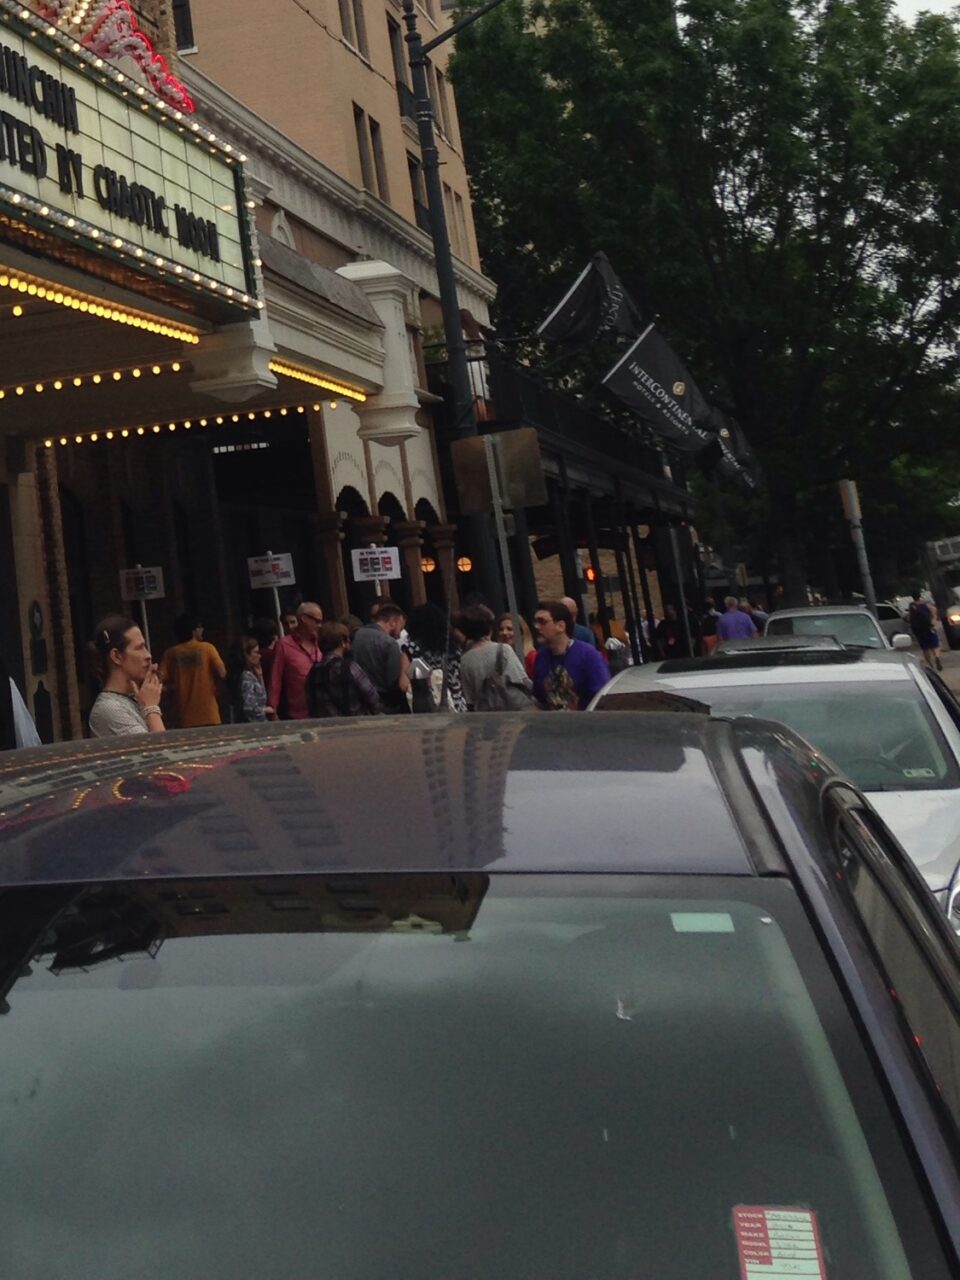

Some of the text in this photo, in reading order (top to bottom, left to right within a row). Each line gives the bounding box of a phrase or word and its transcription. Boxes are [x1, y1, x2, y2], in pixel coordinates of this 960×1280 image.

[55, 143, 84, 199] BY
[93, 164, 170, 238] CHAOTIC
[174, 203, 221, 263] MOON
